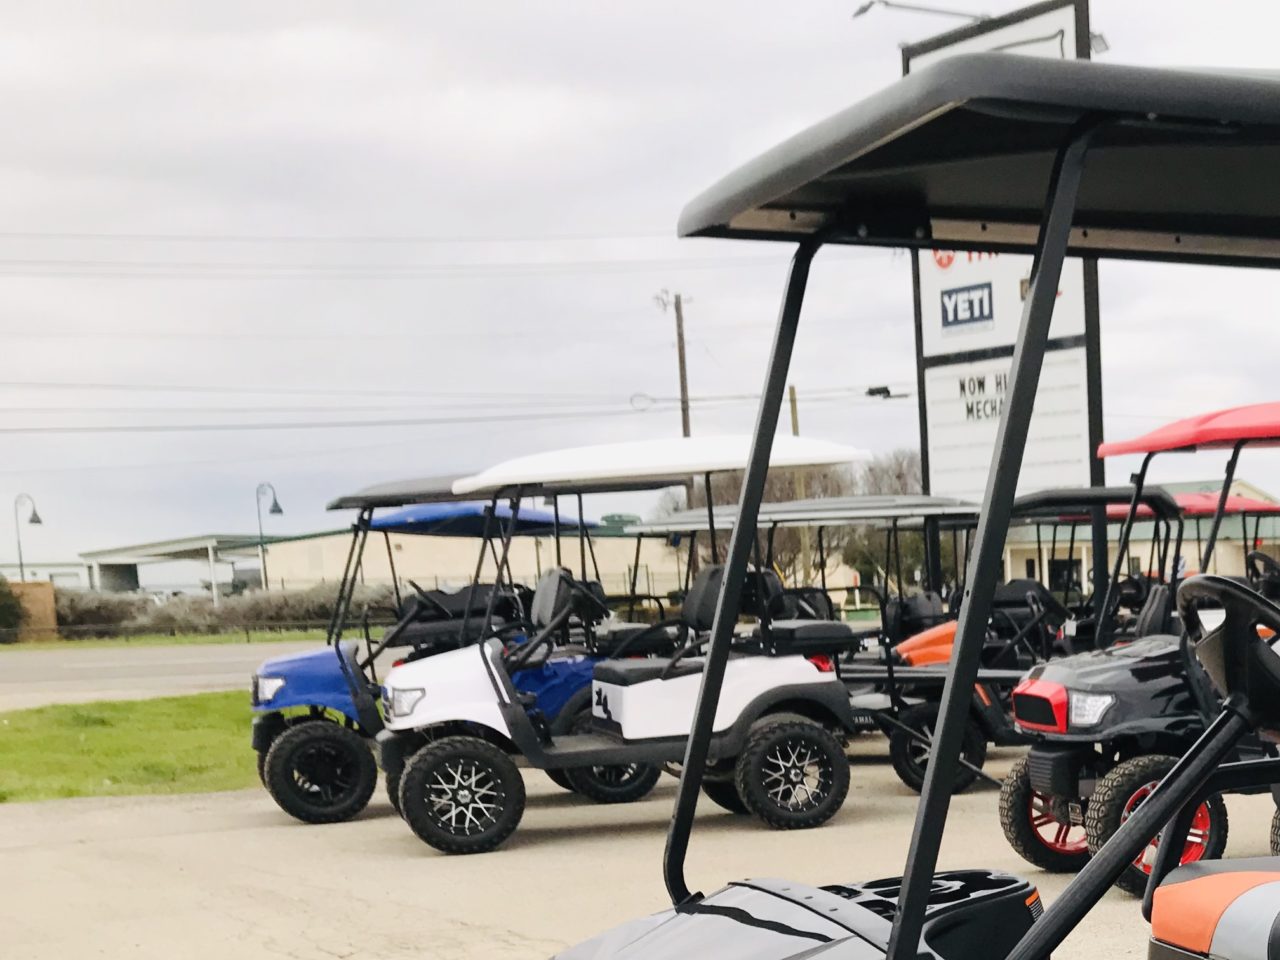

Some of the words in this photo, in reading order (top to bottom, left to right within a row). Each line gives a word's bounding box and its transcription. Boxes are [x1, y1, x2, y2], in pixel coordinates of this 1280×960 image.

[943, 287, 990, 322] YETI
[959, 376, 985, 397] NOW
[995, 373, 1007, 393] HI
[966, 398, 1003, 420] MECHA
